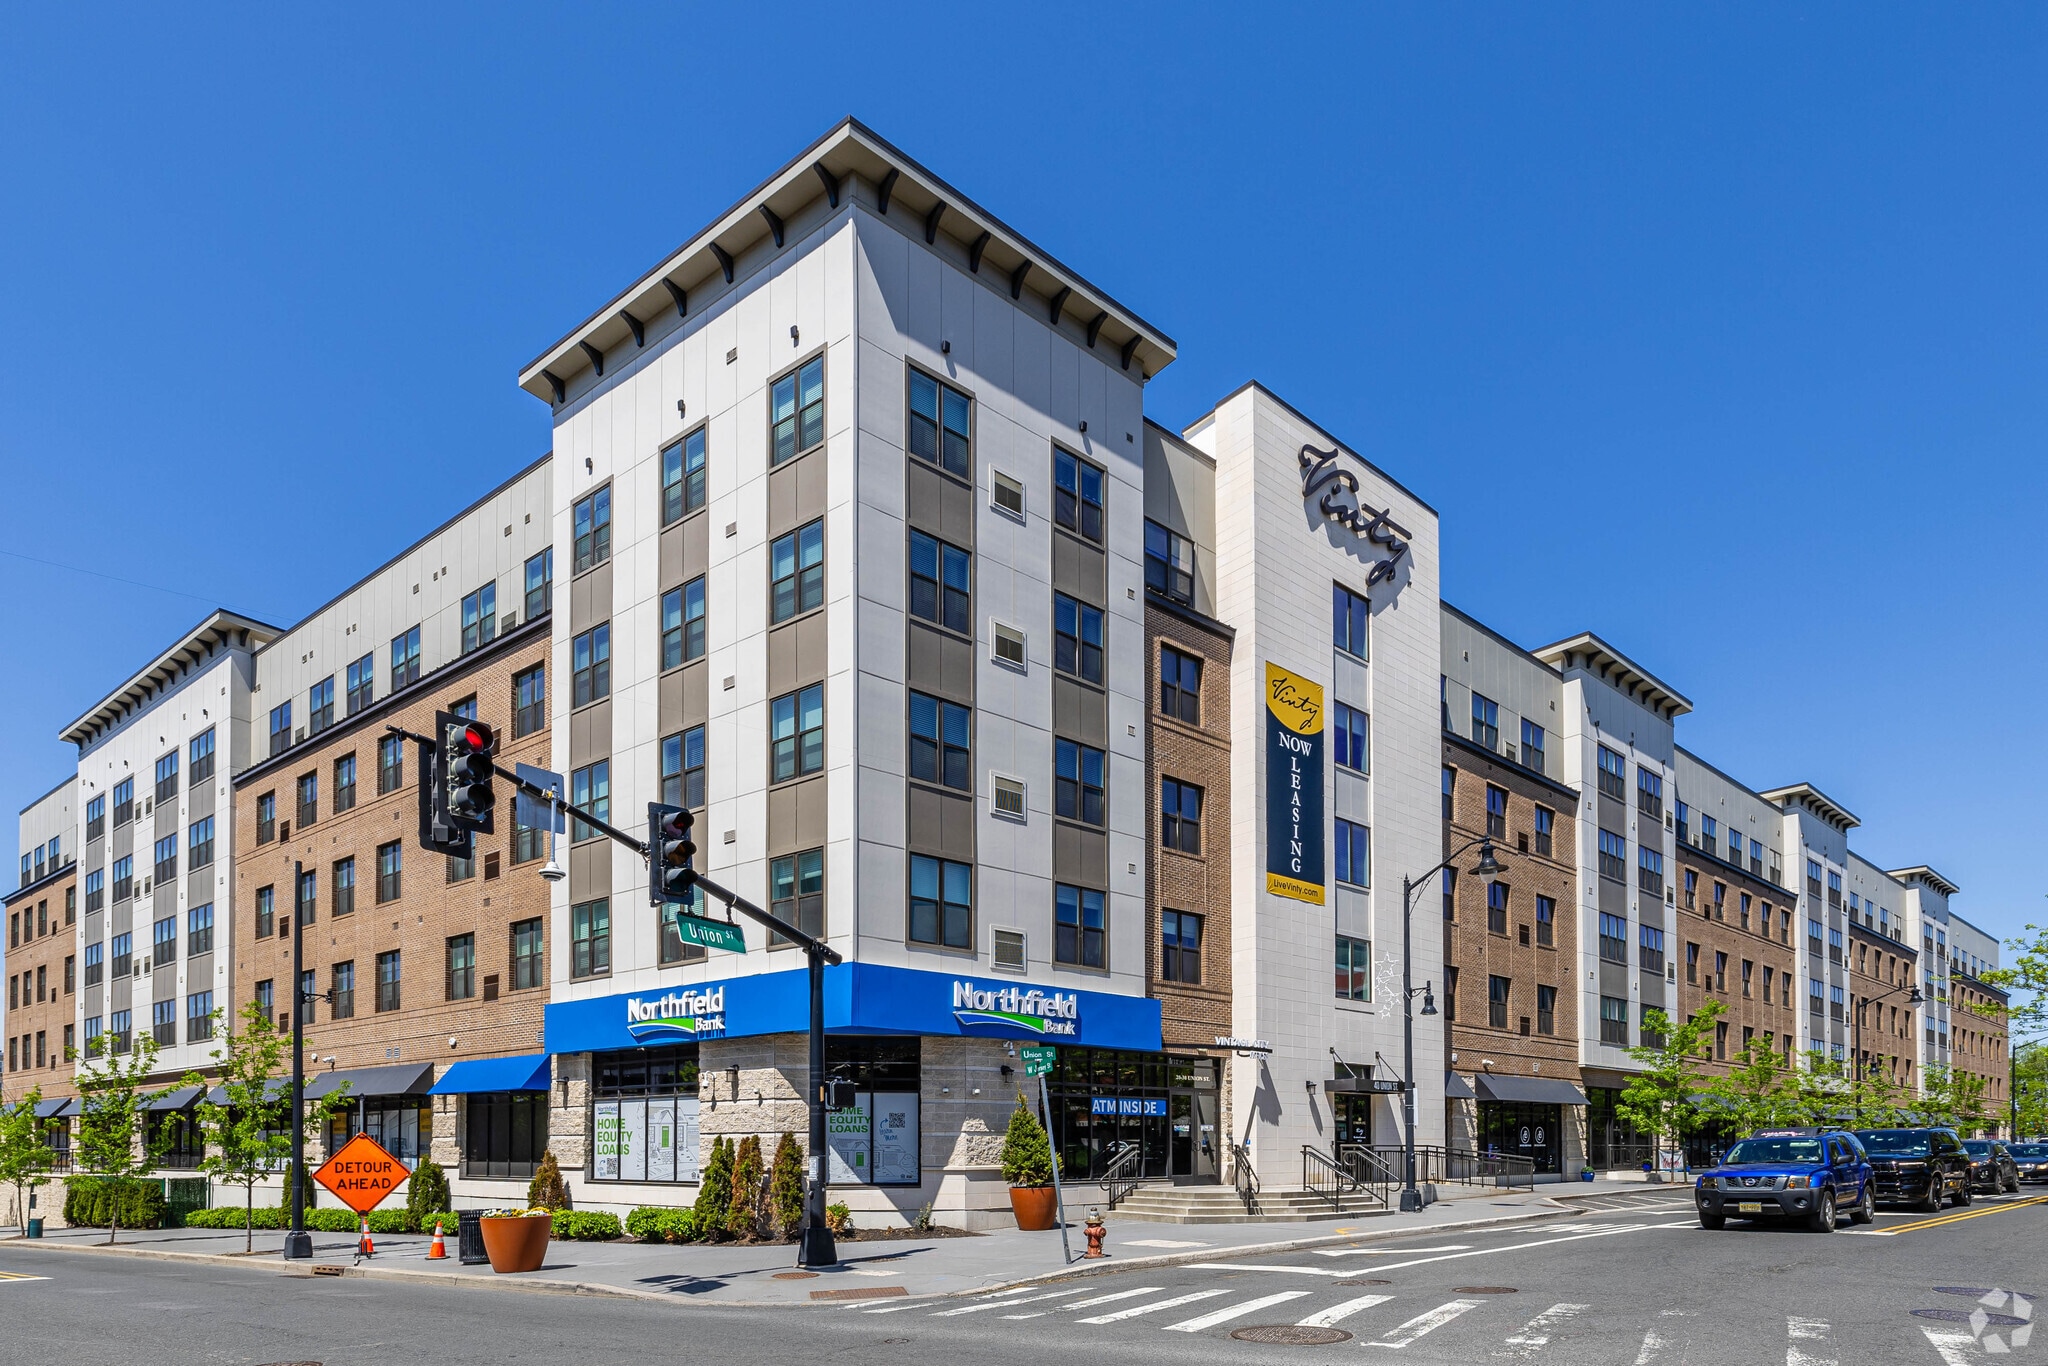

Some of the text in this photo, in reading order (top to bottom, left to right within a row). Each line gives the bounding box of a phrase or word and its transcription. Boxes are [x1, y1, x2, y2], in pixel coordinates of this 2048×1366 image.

[1298, 443, 1412, 587] Vinty
[1271, 677, 1320, 731] Vinty
[1278, 732, 1312, 757] NOW
[1290, 757, 1302, 873] LEASING
[1273, 877, 1319, 898] LiveVinty.com
[688, 922, 724, 944] Union
[627, 985, 726, 1023] Northfield
[953, 980, 1077, 1019] Northfield
[695, 1014, 726, 1032] Bank
[1043, 1018, 1076, 1035] Bank
[1023, 1050, 1042, 1058] Union
[1092, 1099, 1157, 1114] ATM INSIDE
[829, 1115, 871, 1125] EQUITY
[829, 1125, 869, 1133] LOANS
[597, 1131, 633, 1143] EQUTY
[334, 1161, 392, 1174] DETOUR
[336, 1177, 391, 1190] AHEAD
